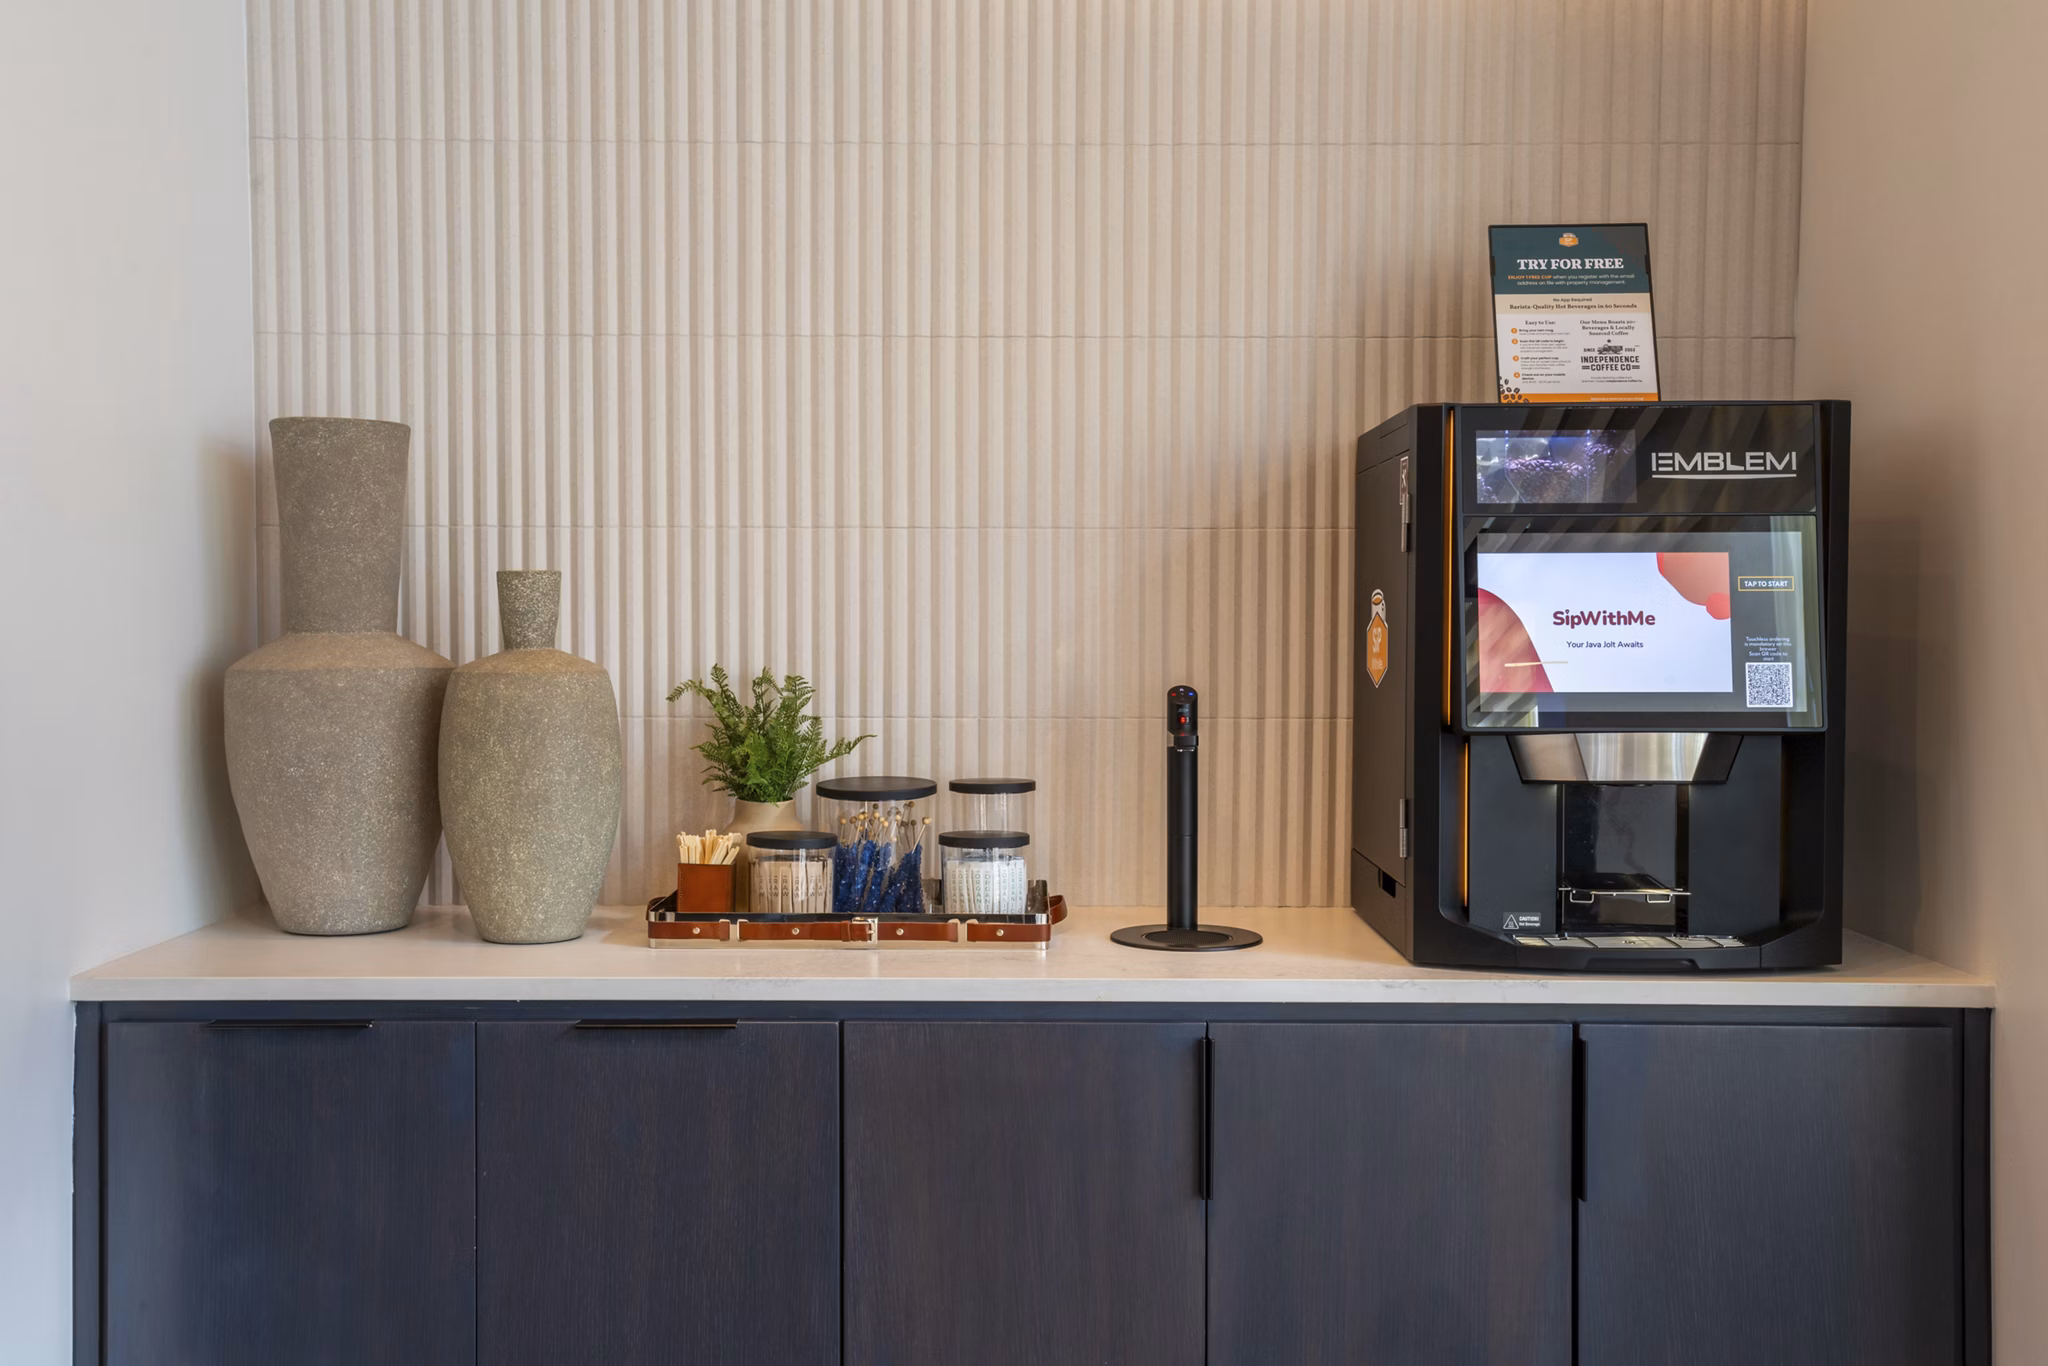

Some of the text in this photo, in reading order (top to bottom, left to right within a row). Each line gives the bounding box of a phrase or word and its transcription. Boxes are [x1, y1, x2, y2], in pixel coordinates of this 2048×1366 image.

[1517, 258, 1624, 270] TRY FOR FREE
[1651, 452, 1797, 471] EMBLEM
[1553, 609, 1656, 629] SipWithMe
